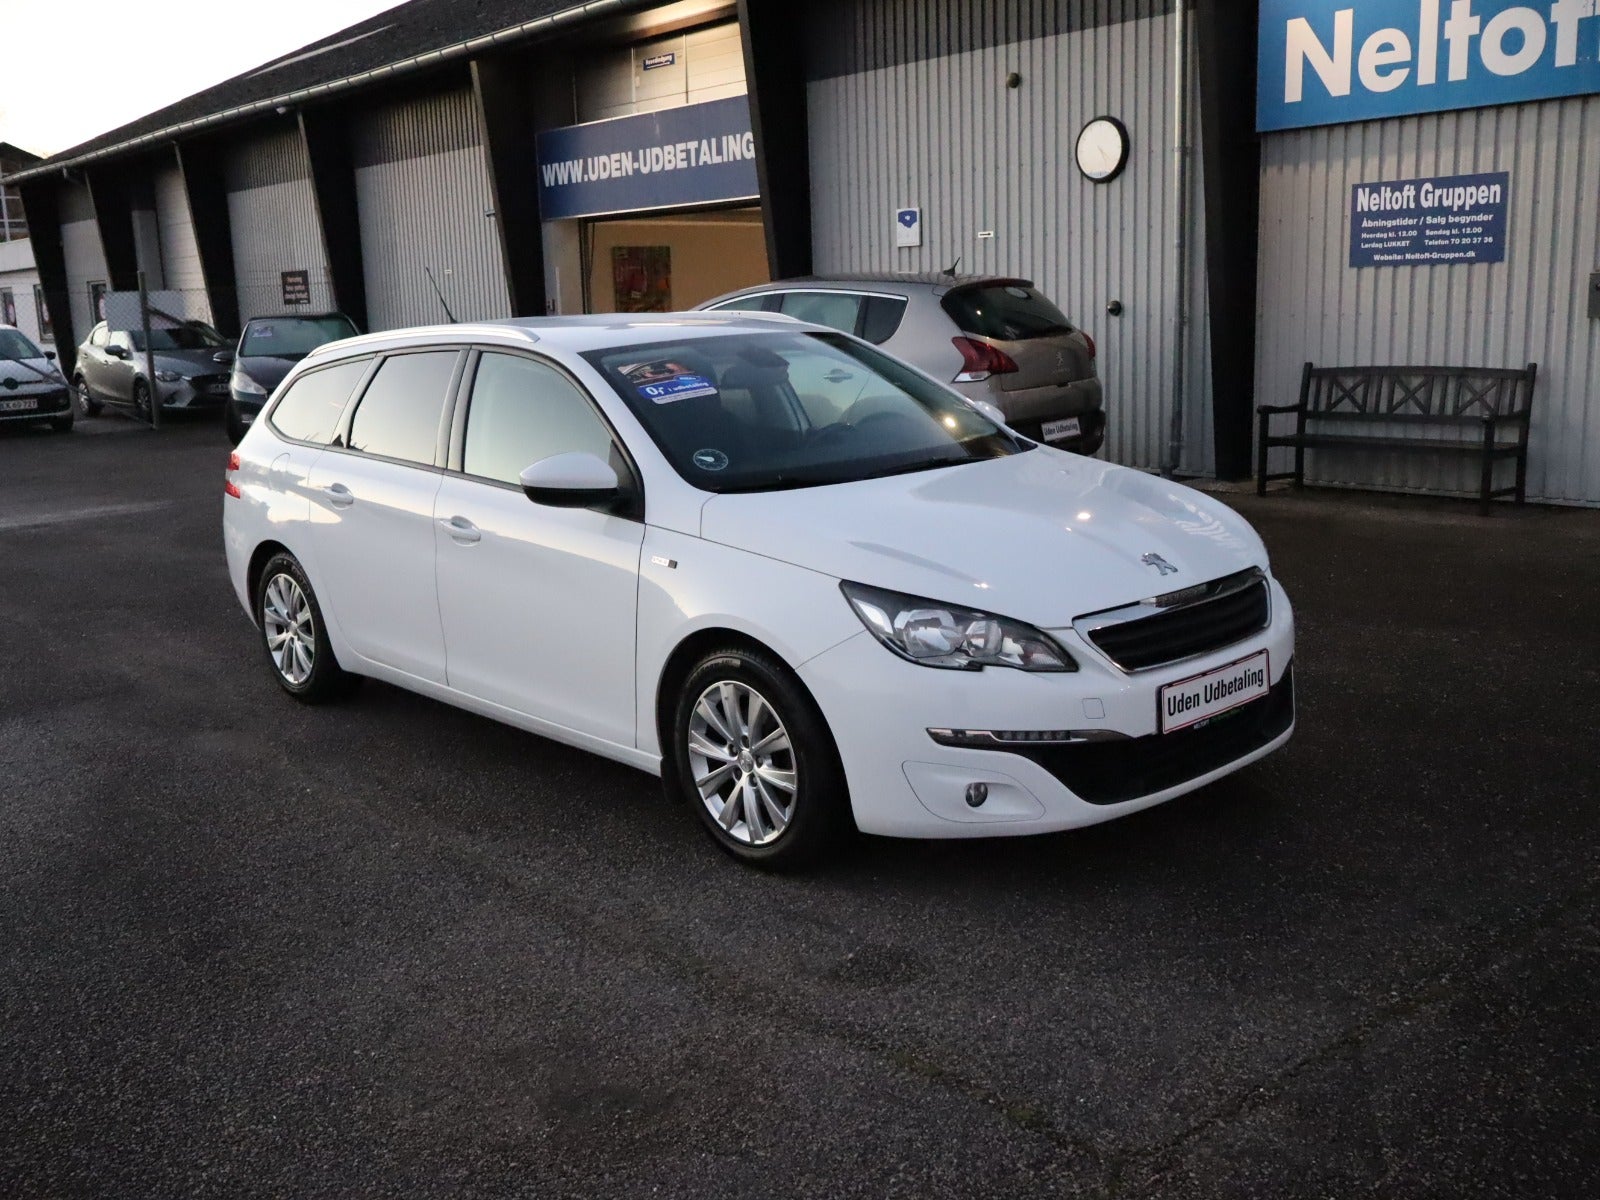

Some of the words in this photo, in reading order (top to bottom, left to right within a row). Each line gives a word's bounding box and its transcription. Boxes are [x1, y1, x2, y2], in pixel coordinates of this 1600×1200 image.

[1356, 184, 1416, 212] Neltoft
[1420, 182, 1501, 212] Gruppen
[1361, 217, 1418, 228] Åbningstider
[1419, 216, 1425, 226] /
[1425, 215, 1447, 225] Salg
[1447, 213, 1494, 223] begynder
[1461, 226, 1483, 234] 12.00
[1383, 240, 1411, 248] LUKKET
[1472, 236, 1482, 244] 37
[1373, 252, 1405, 261] Website:
[1167, 692, 1200, 717] Uden
[1204, 668, 1264, 704] Udbetaling
